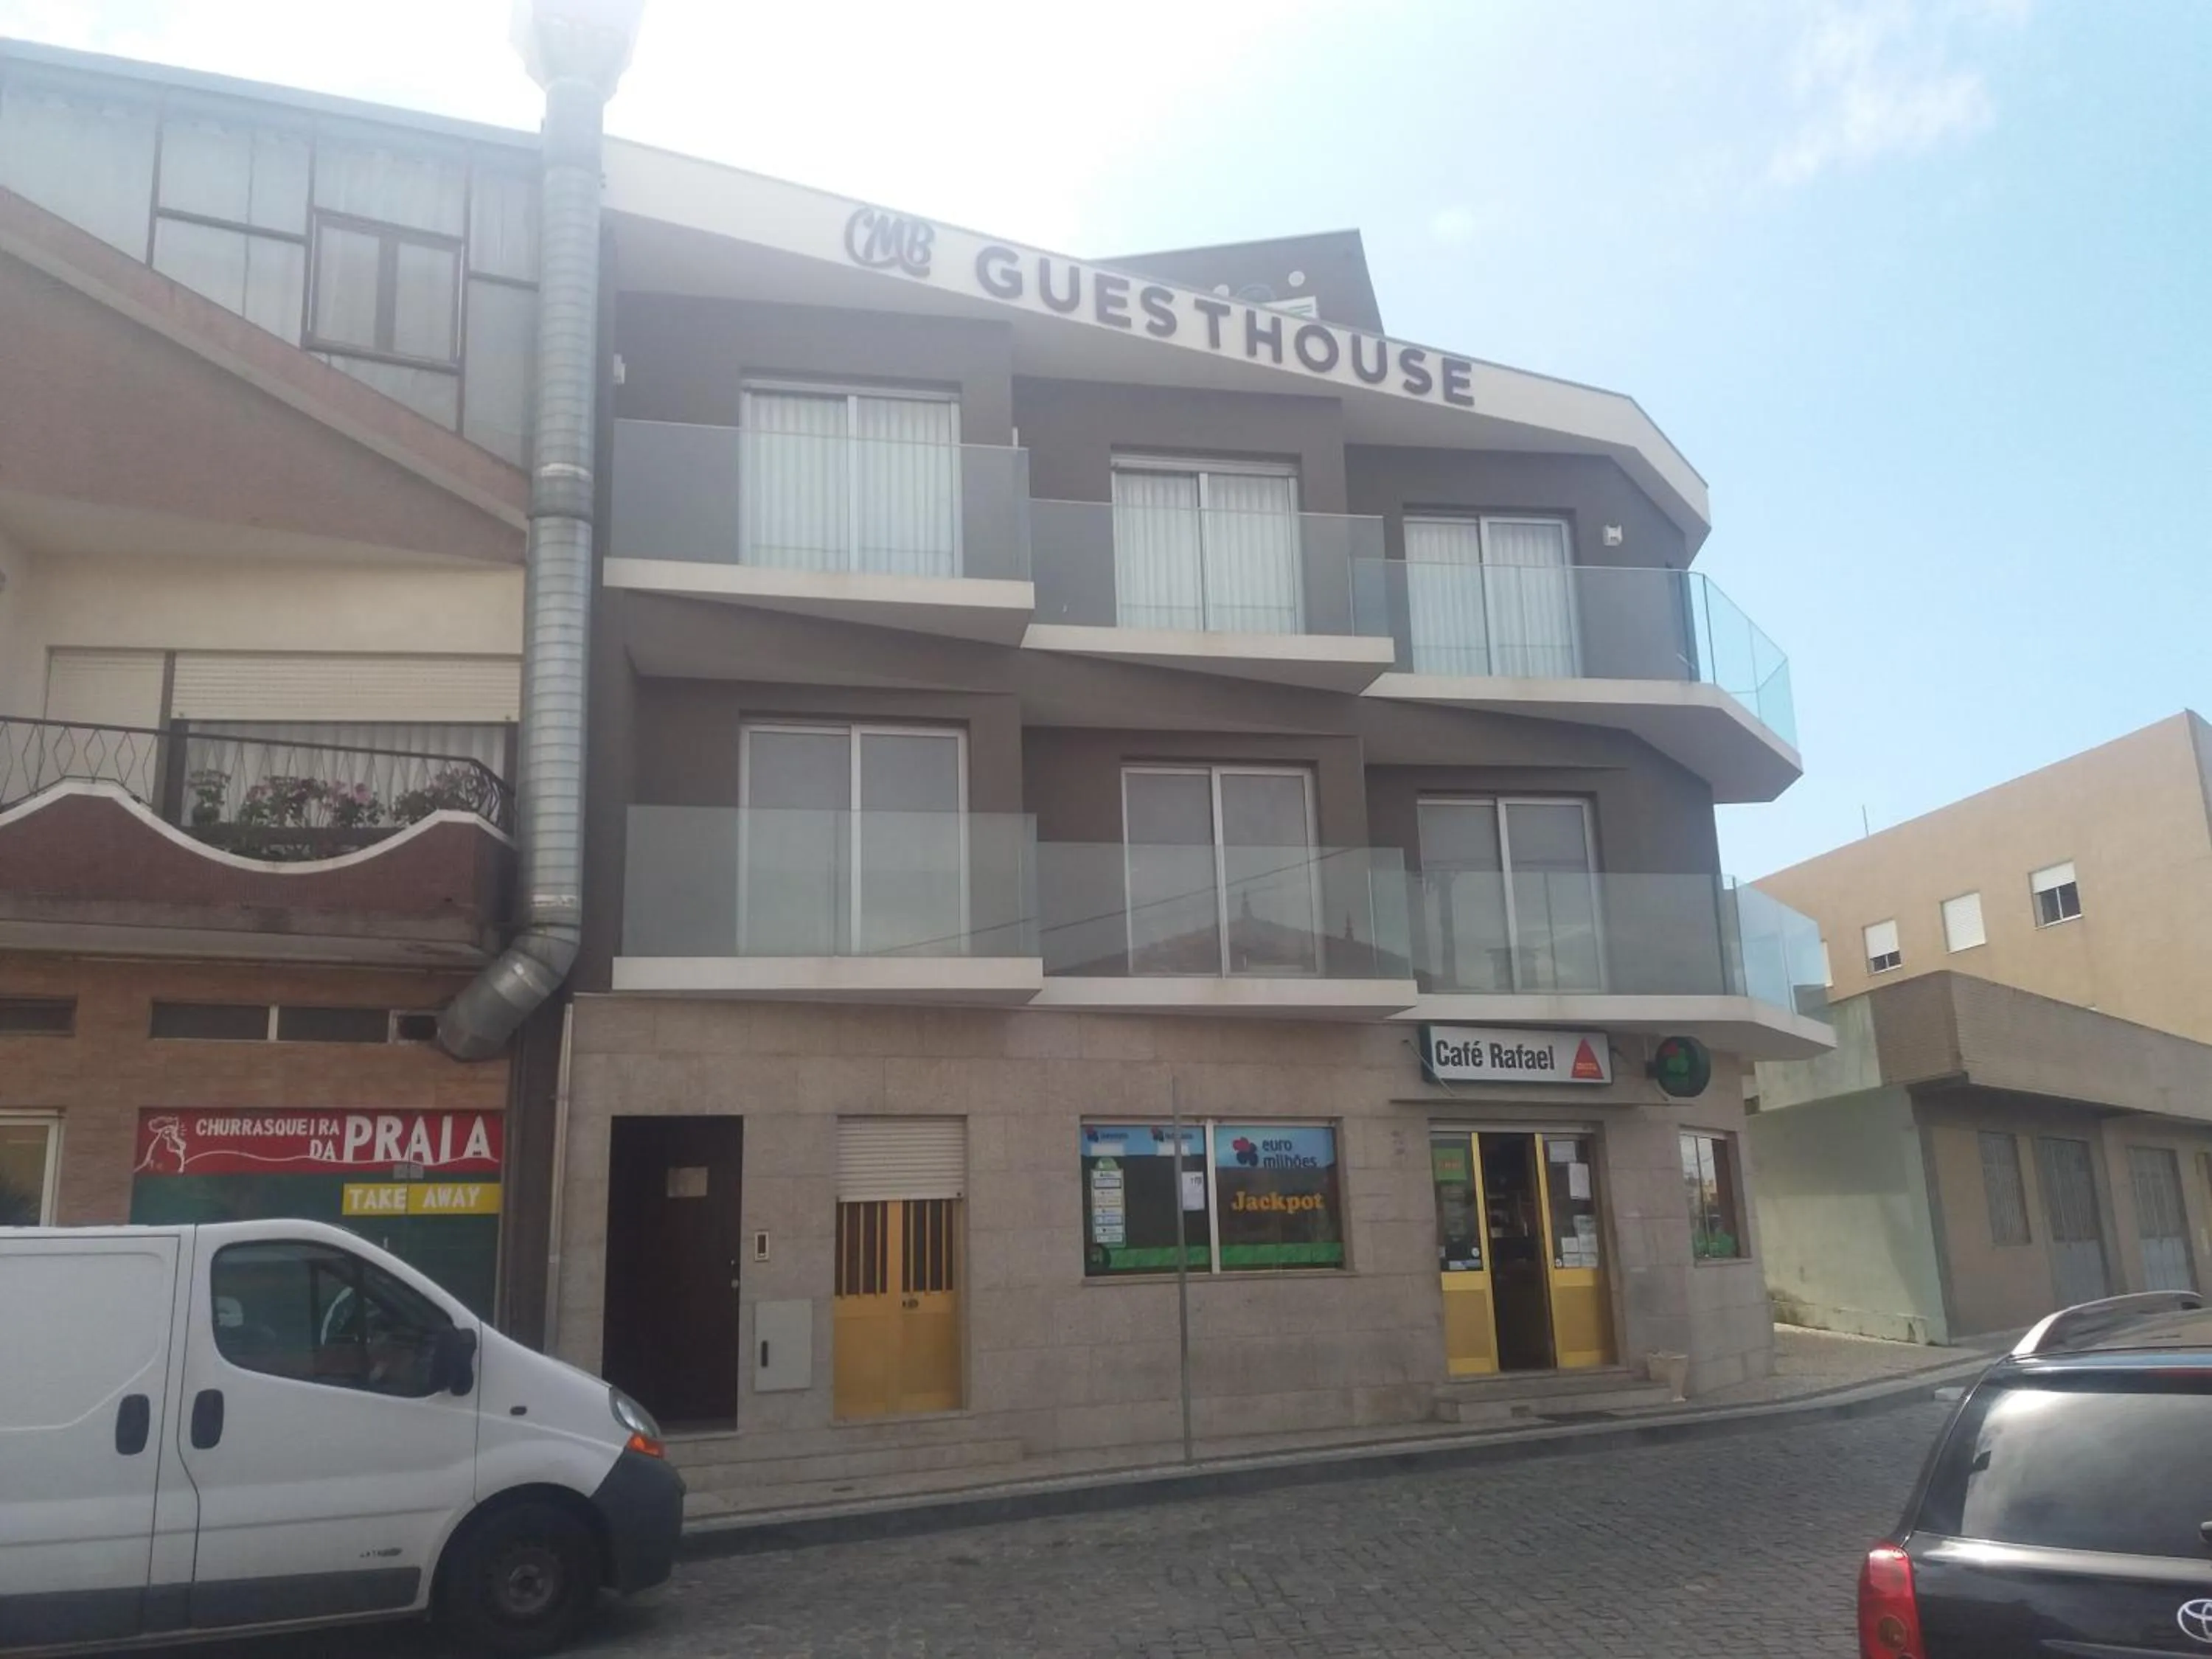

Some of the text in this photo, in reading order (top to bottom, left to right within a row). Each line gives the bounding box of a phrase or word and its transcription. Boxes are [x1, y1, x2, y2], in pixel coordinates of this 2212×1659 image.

[974, 244, 1476, 407] GUESTHOUSE
[1435, 1039, 1555, 1071] Café Rafael
[195, 1115, 493, 1165] CHURRASQUEIRA PRAIA
[309, 1139, 337, 1161] DA
[1262, 1138, 1293, 1151] euro
[1263, 1152, 1318, 1168] milhões
[349, 1187, 481, 1210] TAKE AWAY
[1231, 1190, 1325, 1214] Jackpot
